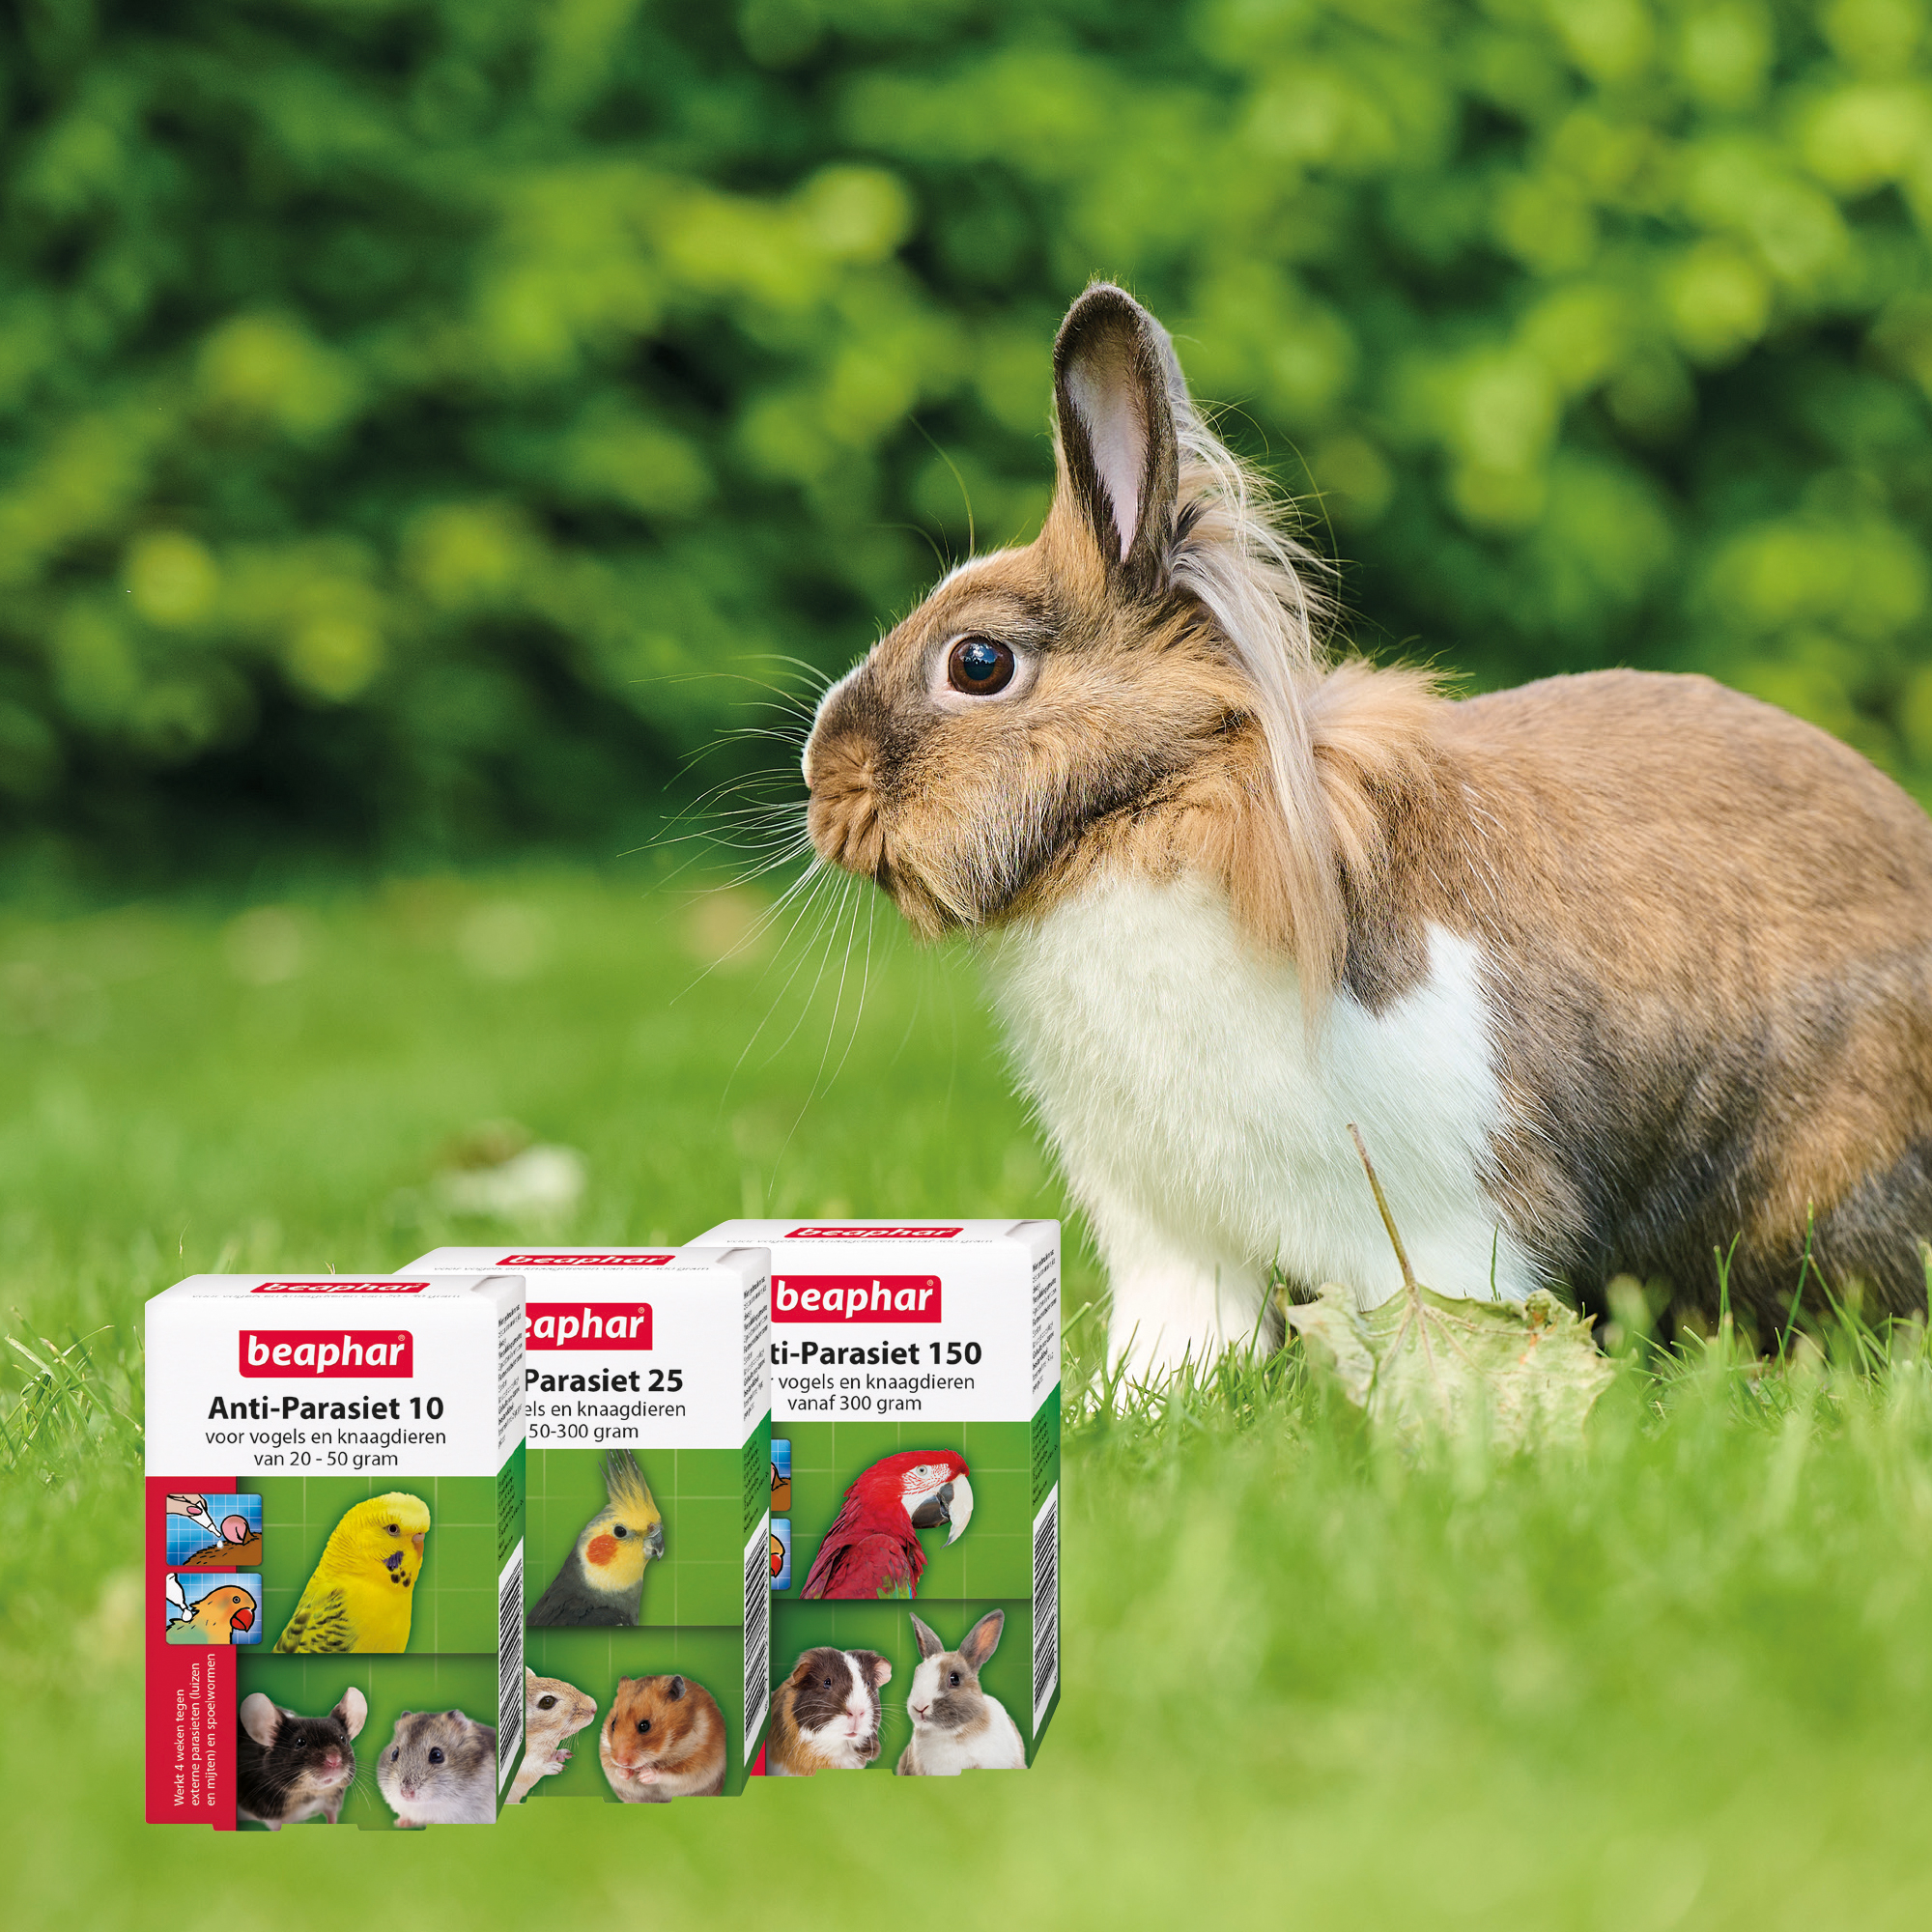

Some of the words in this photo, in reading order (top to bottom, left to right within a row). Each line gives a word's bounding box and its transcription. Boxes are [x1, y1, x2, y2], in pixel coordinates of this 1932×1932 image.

[798, 1228, 947, 1237] beaphar
[508, 1255, 664, 1264] beaphar
[262, 1283, 421, 1293] beaphar
[777, 1279, 933, 1320] beaphar
[526, 1307, 644, 1347] eaphar
[247, 1334, 405, 1374] beaphar
[771, 1340, 921, 1365] ti-Parasiet
[929, 1342, 982, 1365] 150
[526, 1367, 640, 1392] Parasiet
[648, 1368, 683, 1392] 25
[779, 1373, 835, 1393] vogels
[839, 1378, 861, 1389] en
[867, 1373, 975, 1393] knaagdieren
[208, 1395, 400, 1420] Anti-Parasiet
[410, 1396, 444, 1420] 10
[526, 1401, 546, 1417] els
[551, 1405, 572, 1417] en
[578, 1401, 686, 1420] knaagdieren
[787, 1394, 836, 1410] vanaf
[839, 1396, 872, 1410] 300
[876, 1399, 922, 1414] gram
[206, 1432, 245, 1444] voor
[249, 1429, 306, 1448] vogels
[311, 1432, 332, 1444] en
[338, 1429, 446, 1448] knaagdieren
[528, 1424, 588, 1438] 50-300
[593, 1428, 639, 1442] gram
[254, 1455, 284, 1466] van
[290, 1452, 311, 1466] 20
[327, 1452, 349, 1466] 50
[353, 1455, 398, 1470] gram
[188, 1662, 201, 1699] (luizen
[205, 1653, 218, 1730] spoelwormen
[176, 1689, 187, 1722] tegen
[174, 1724, 185, 1762] weken
[189, 1702, 202, 1761] parasieten
[207, 1733, 215, 1747] en
[205, 1749, 218, 1789] mijten)
[174, 1774, 185, 1806] Werkt
[190, 1764, 200, 1806] externe
[207, 1792, 215, 1806] en
